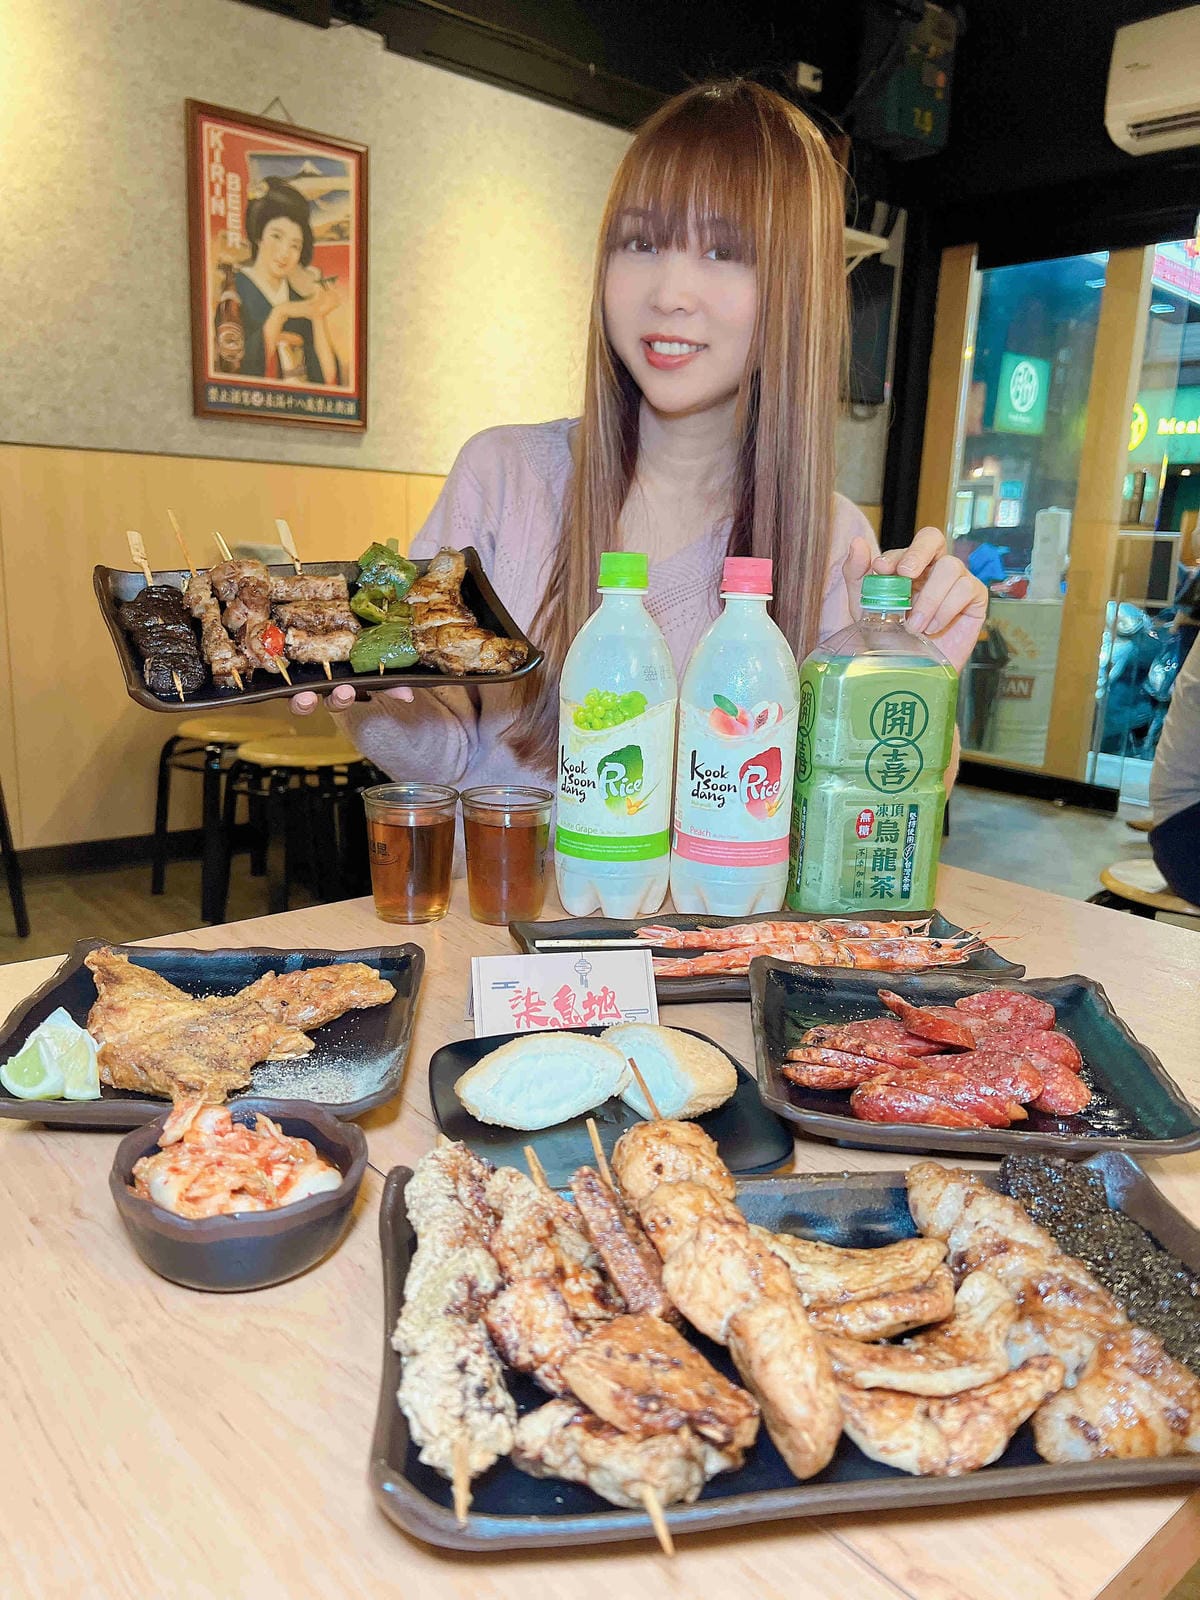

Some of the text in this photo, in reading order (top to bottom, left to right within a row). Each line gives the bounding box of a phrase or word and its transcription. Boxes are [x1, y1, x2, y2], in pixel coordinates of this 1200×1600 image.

[209, 128, 225, 216] KIRIN
[226, 172, 241, 249] BEER
[877, 701, 917, 786] 開喜
[561, 745, 588, 775] Kook
[690, 750, 729, 780] Kook
[561, 776, 586, 803] dang
[568, 773, 596, 789] Soon
[600, 762, 642, 800] Rice
[691, 781, 725, 808] dang
[702, 779, 737, 793] Soon
[741, 765, 780, 803] Rice
[575, 823, 598, 835] Grape
[690, 826, 711, 838] Peach
[869, 820, 900, 899] 烏龍茶
